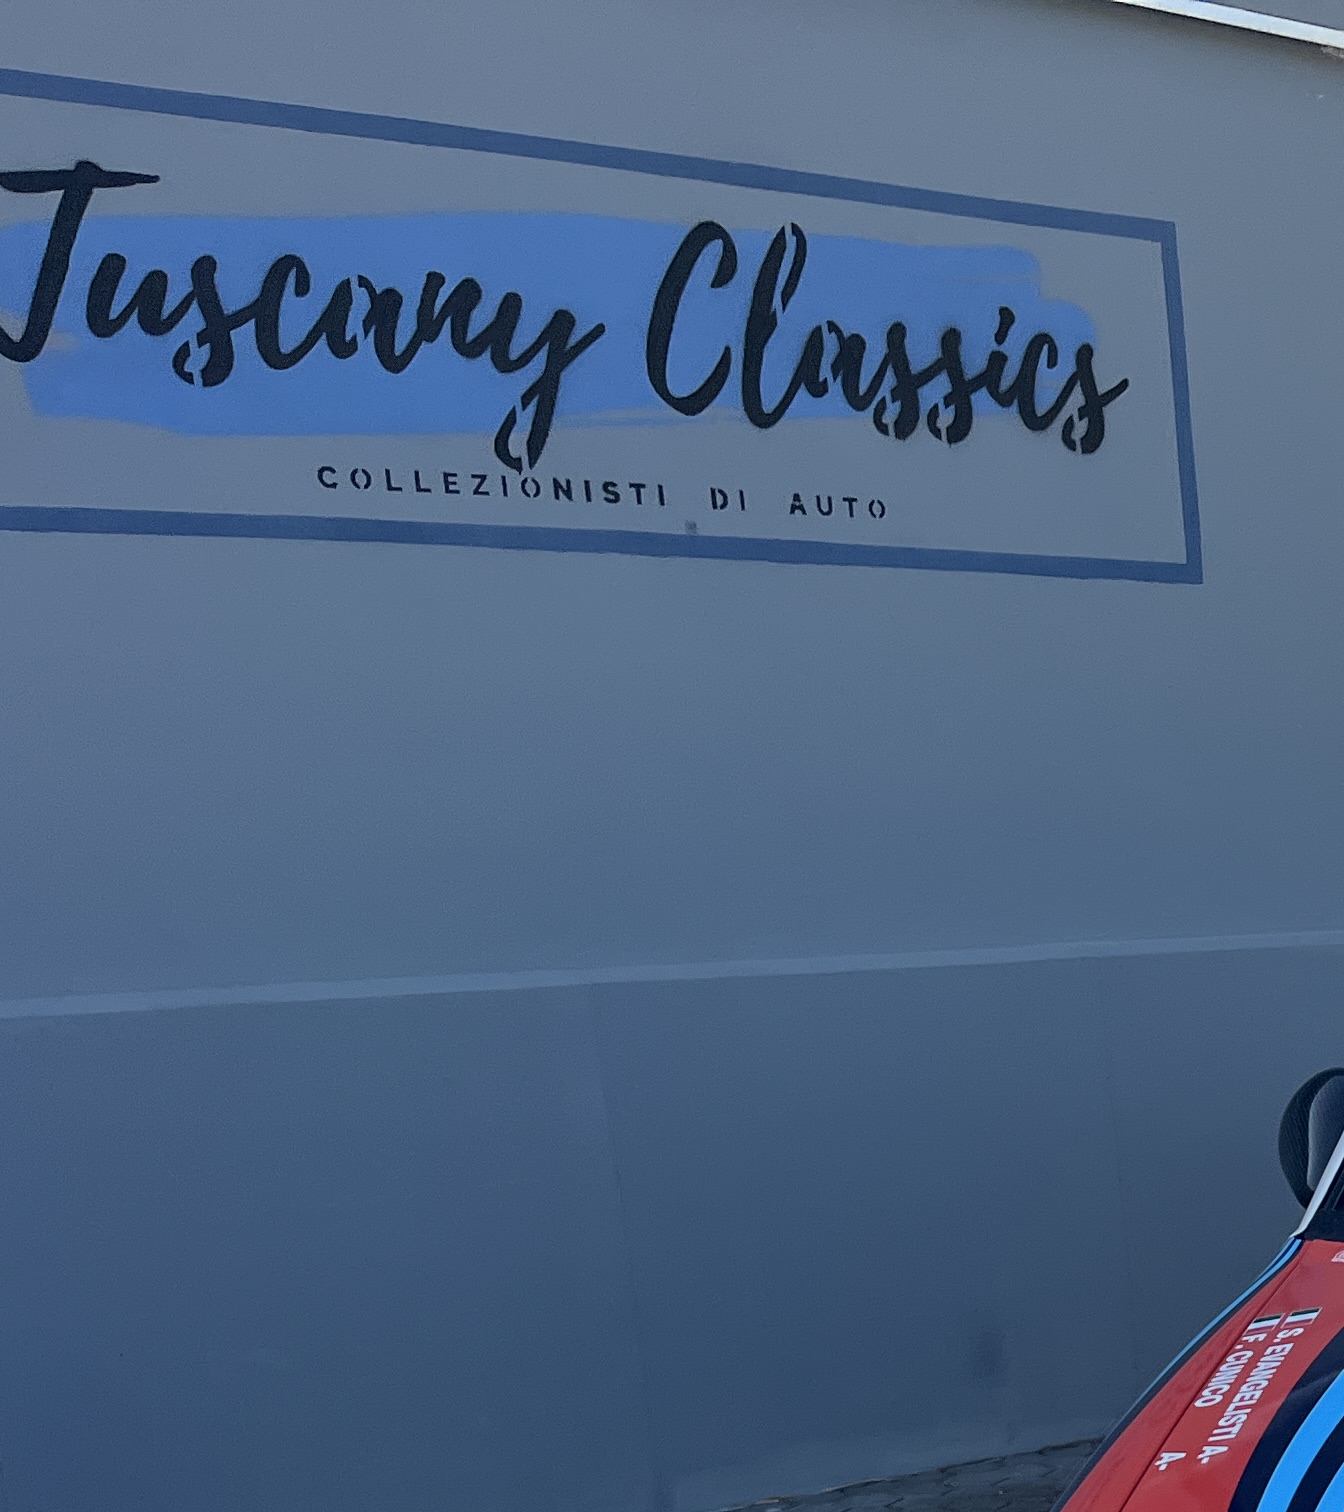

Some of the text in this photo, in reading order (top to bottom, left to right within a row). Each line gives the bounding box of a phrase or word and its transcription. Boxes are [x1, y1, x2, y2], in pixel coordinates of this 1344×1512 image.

[0, 160, 1130, 474] Tuscany Classics
[316, 464, 888, 520] COLLEZIONISTI DI AUTO
[1193, 1350, 1254, 1408] CUNICO
[1207, 1342, 1295, 1442] EVANGELISTI
